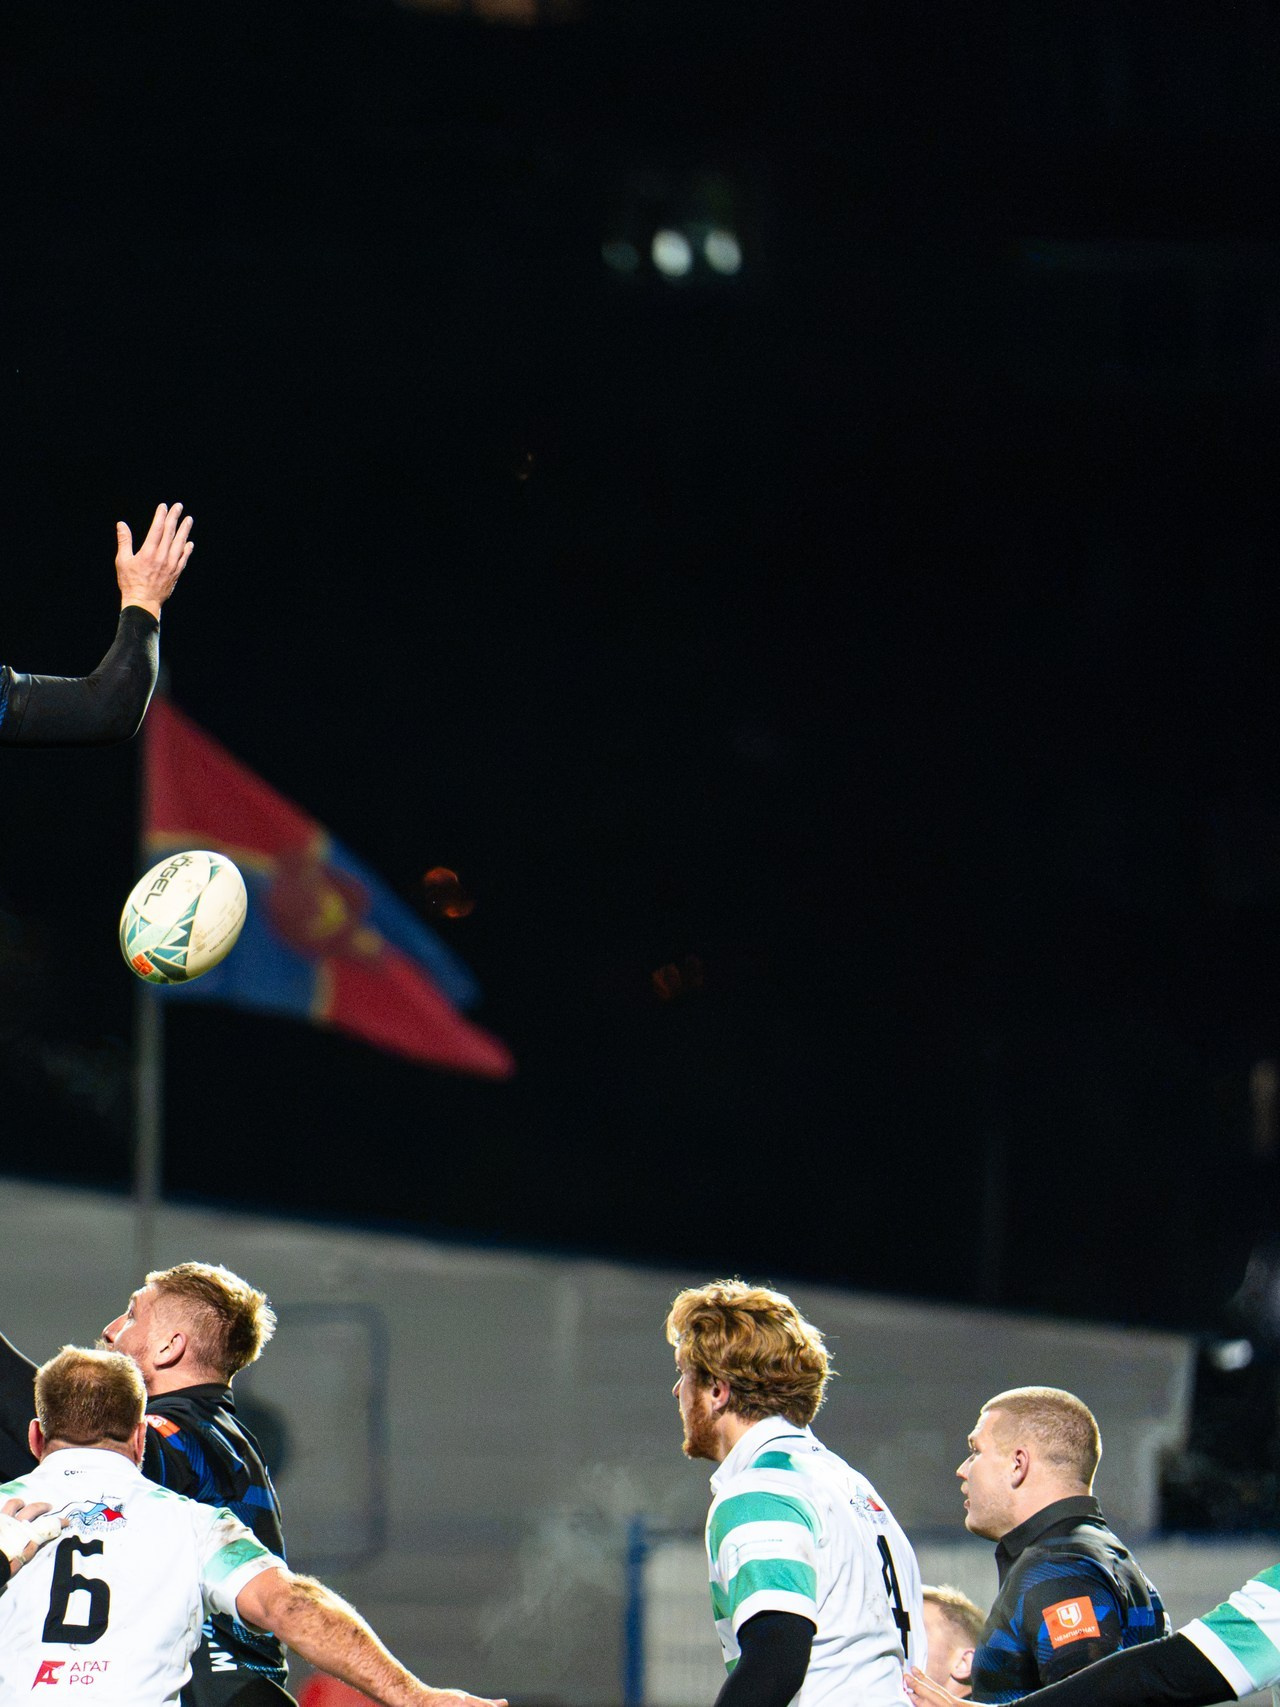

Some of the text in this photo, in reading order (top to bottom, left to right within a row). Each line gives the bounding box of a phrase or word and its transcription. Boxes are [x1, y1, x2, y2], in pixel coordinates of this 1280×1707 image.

[143, 854, 193, 905] ÖGEL
[42, 1535, 111, 1645] 6
[877, 1534, 912, 1660] 4
[69, 1660, 112, 1673] АГАТ
[69, 1674, 95, 1686] РФ
